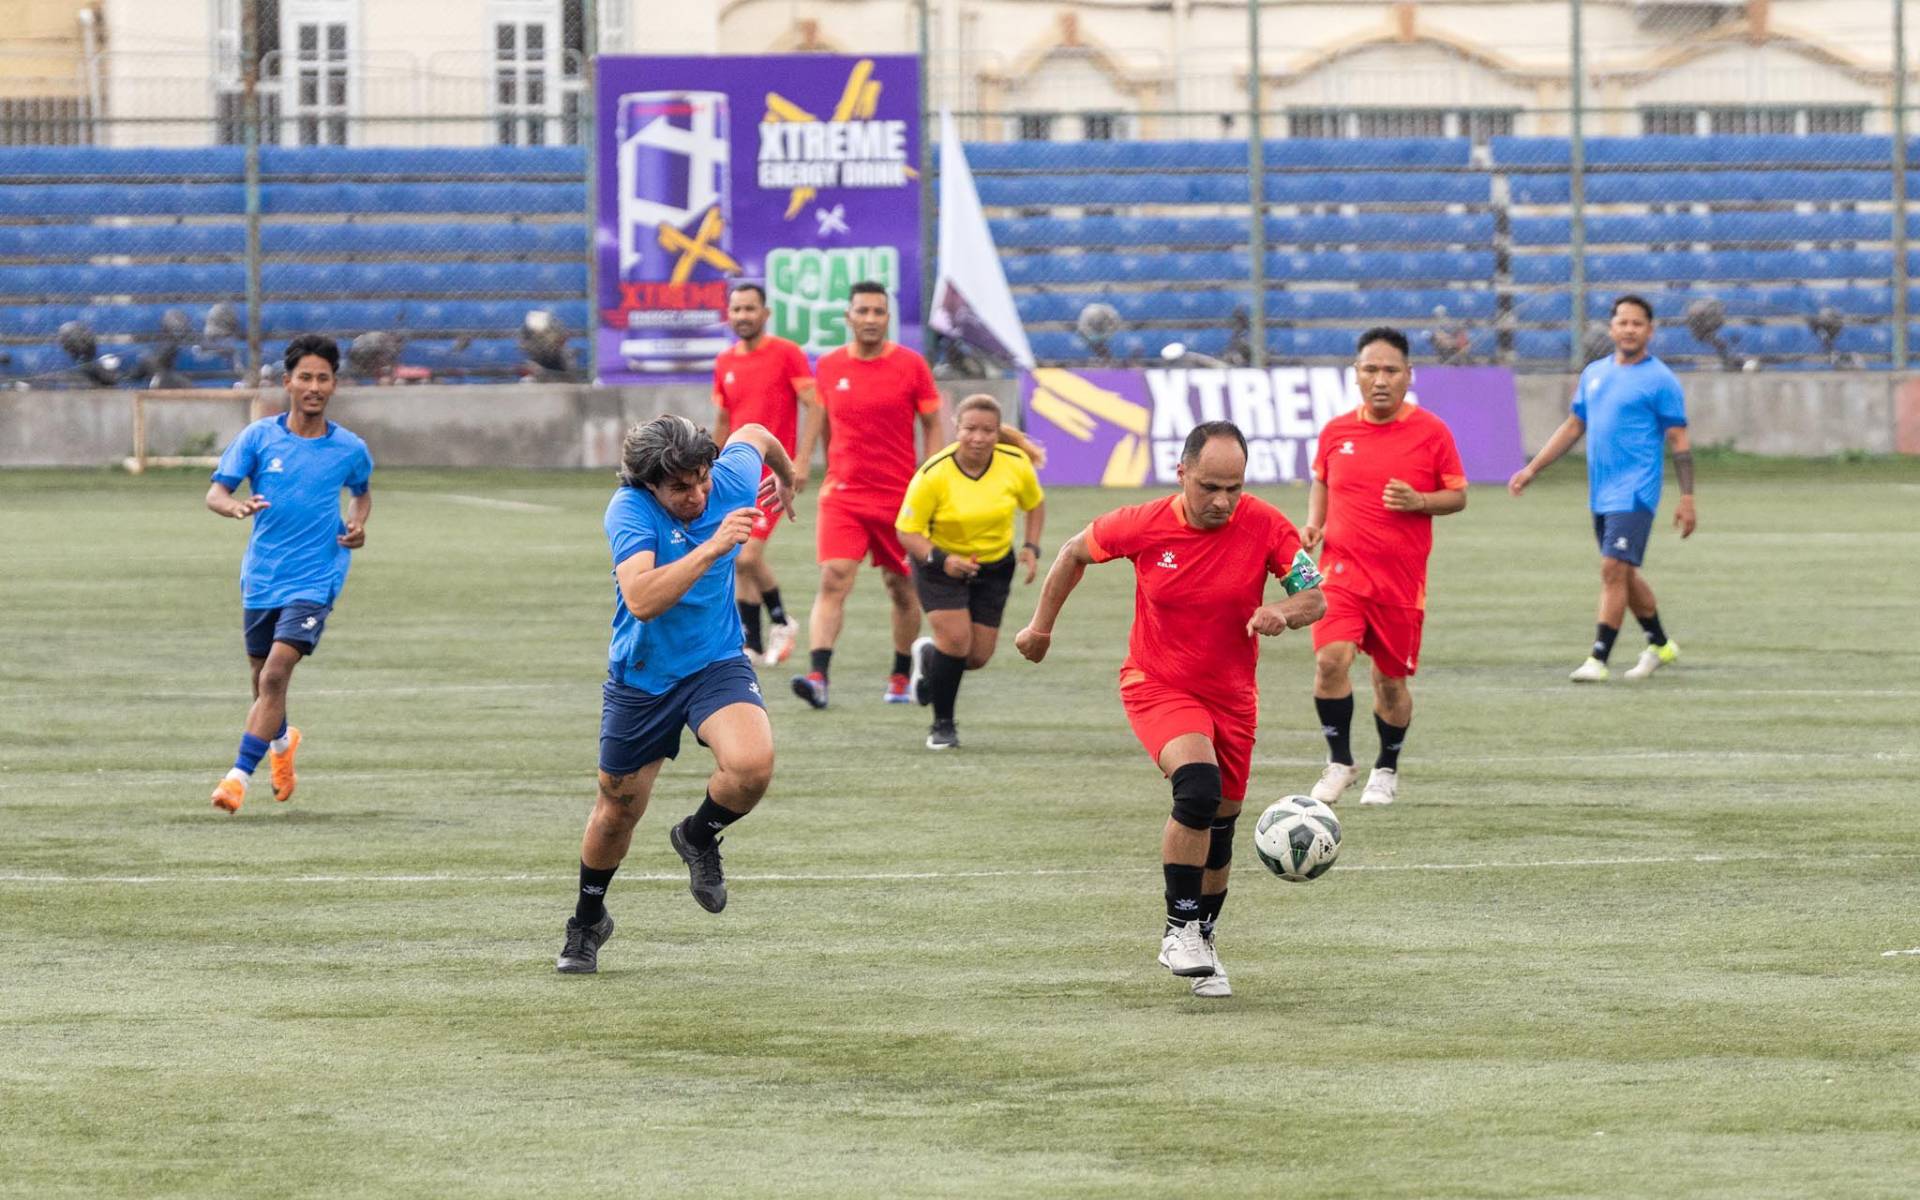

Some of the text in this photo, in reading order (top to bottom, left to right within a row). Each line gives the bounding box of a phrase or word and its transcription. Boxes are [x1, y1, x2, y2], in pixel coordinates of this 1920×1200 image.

[758, 120, 907, 161] XTREME
[1146, 367, 1419, 439] XTREM
[1152, 438, 1298, 484] EGY
